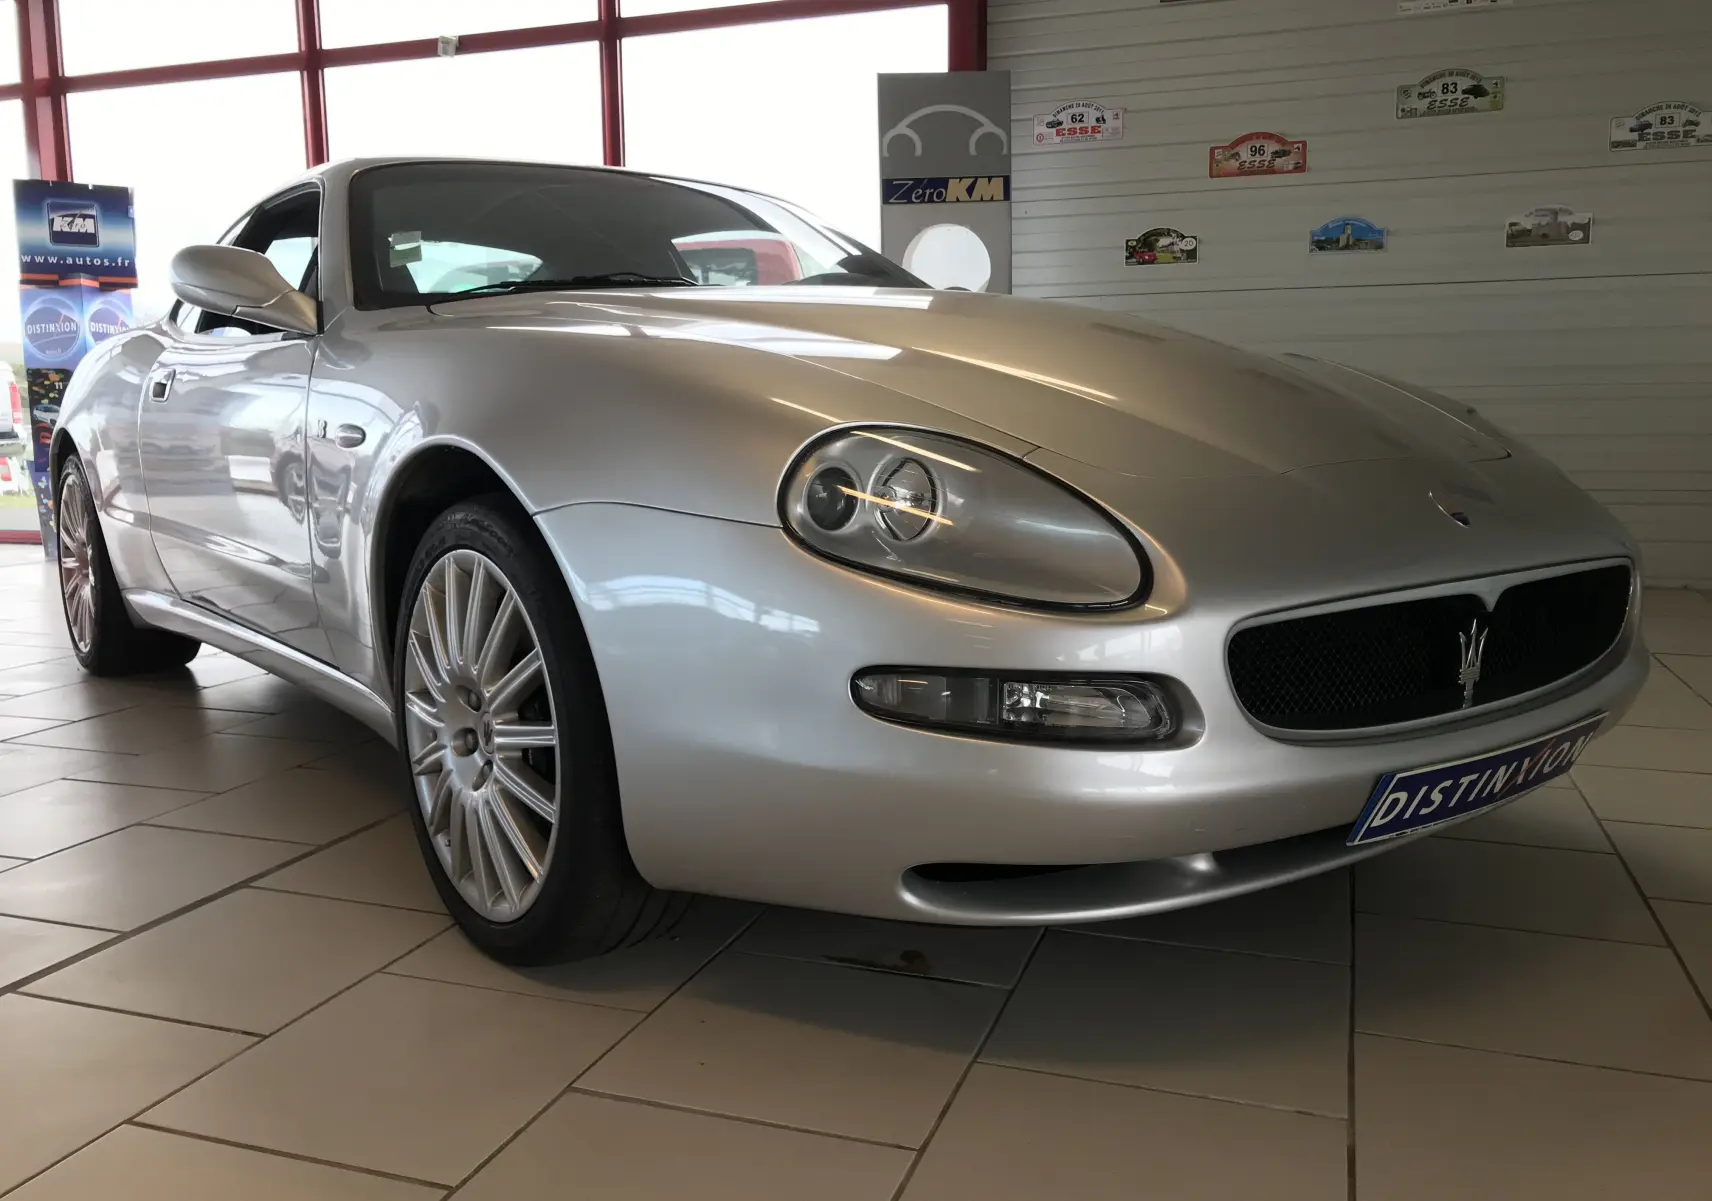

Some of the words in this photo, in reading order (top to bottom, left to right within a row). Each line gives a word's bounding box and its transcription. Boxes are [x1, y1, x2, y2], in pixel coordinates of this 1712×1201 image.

[1441, 82, 1458, 94] 83
[1426, 97, 1470, 110] ESSE
[1052, 103, 1074, 118] DIMANCHE
[1071, 113, 1085, 123] 62
[1659, 116, 1675, 126] 83
[1055, 125, 1102, 137] ESSE
[1638, 129, 1697, 142] ESSE
[1250, 145, 1266, 156] 96
[1237, 159, 1277, 170] ESSE
[20, 254, 130, 268] www.autos.fr
[27, 321, 77, 335] DISTINXION
[1369, 732, 1595, 829] DISTINXION
